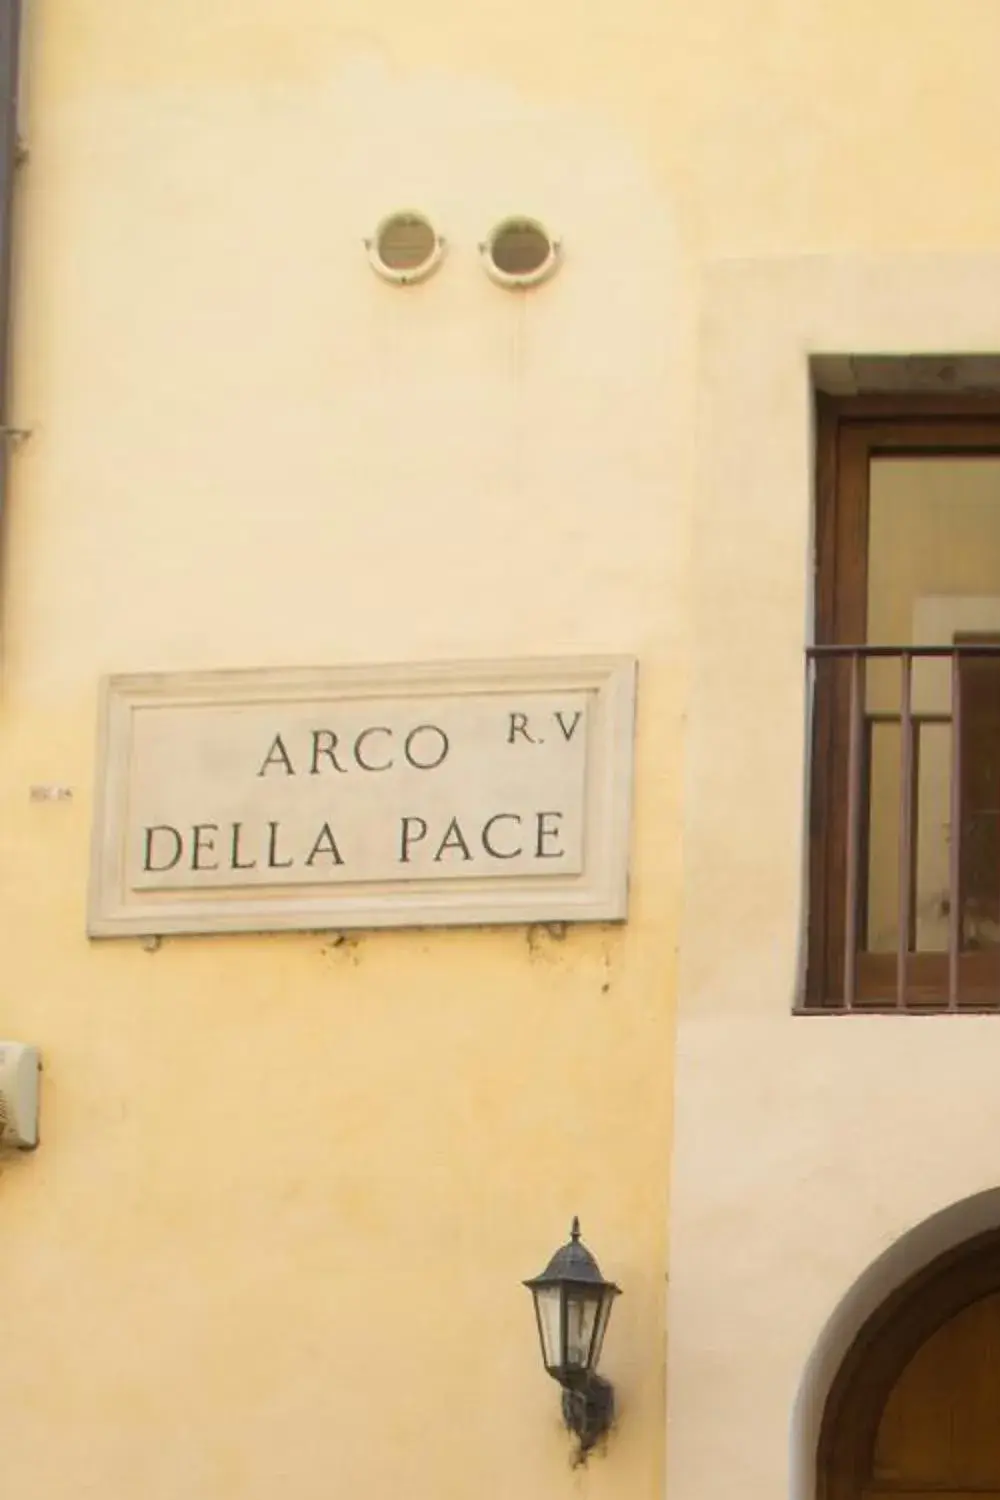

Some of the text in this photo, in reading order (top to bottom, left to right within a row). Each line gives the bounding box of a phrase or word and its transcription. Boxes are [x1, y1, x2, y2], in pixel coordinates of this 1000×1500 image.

[257, 724, 450, 777] ARCO
[143, 811, 565, 872] DELLA PACE
